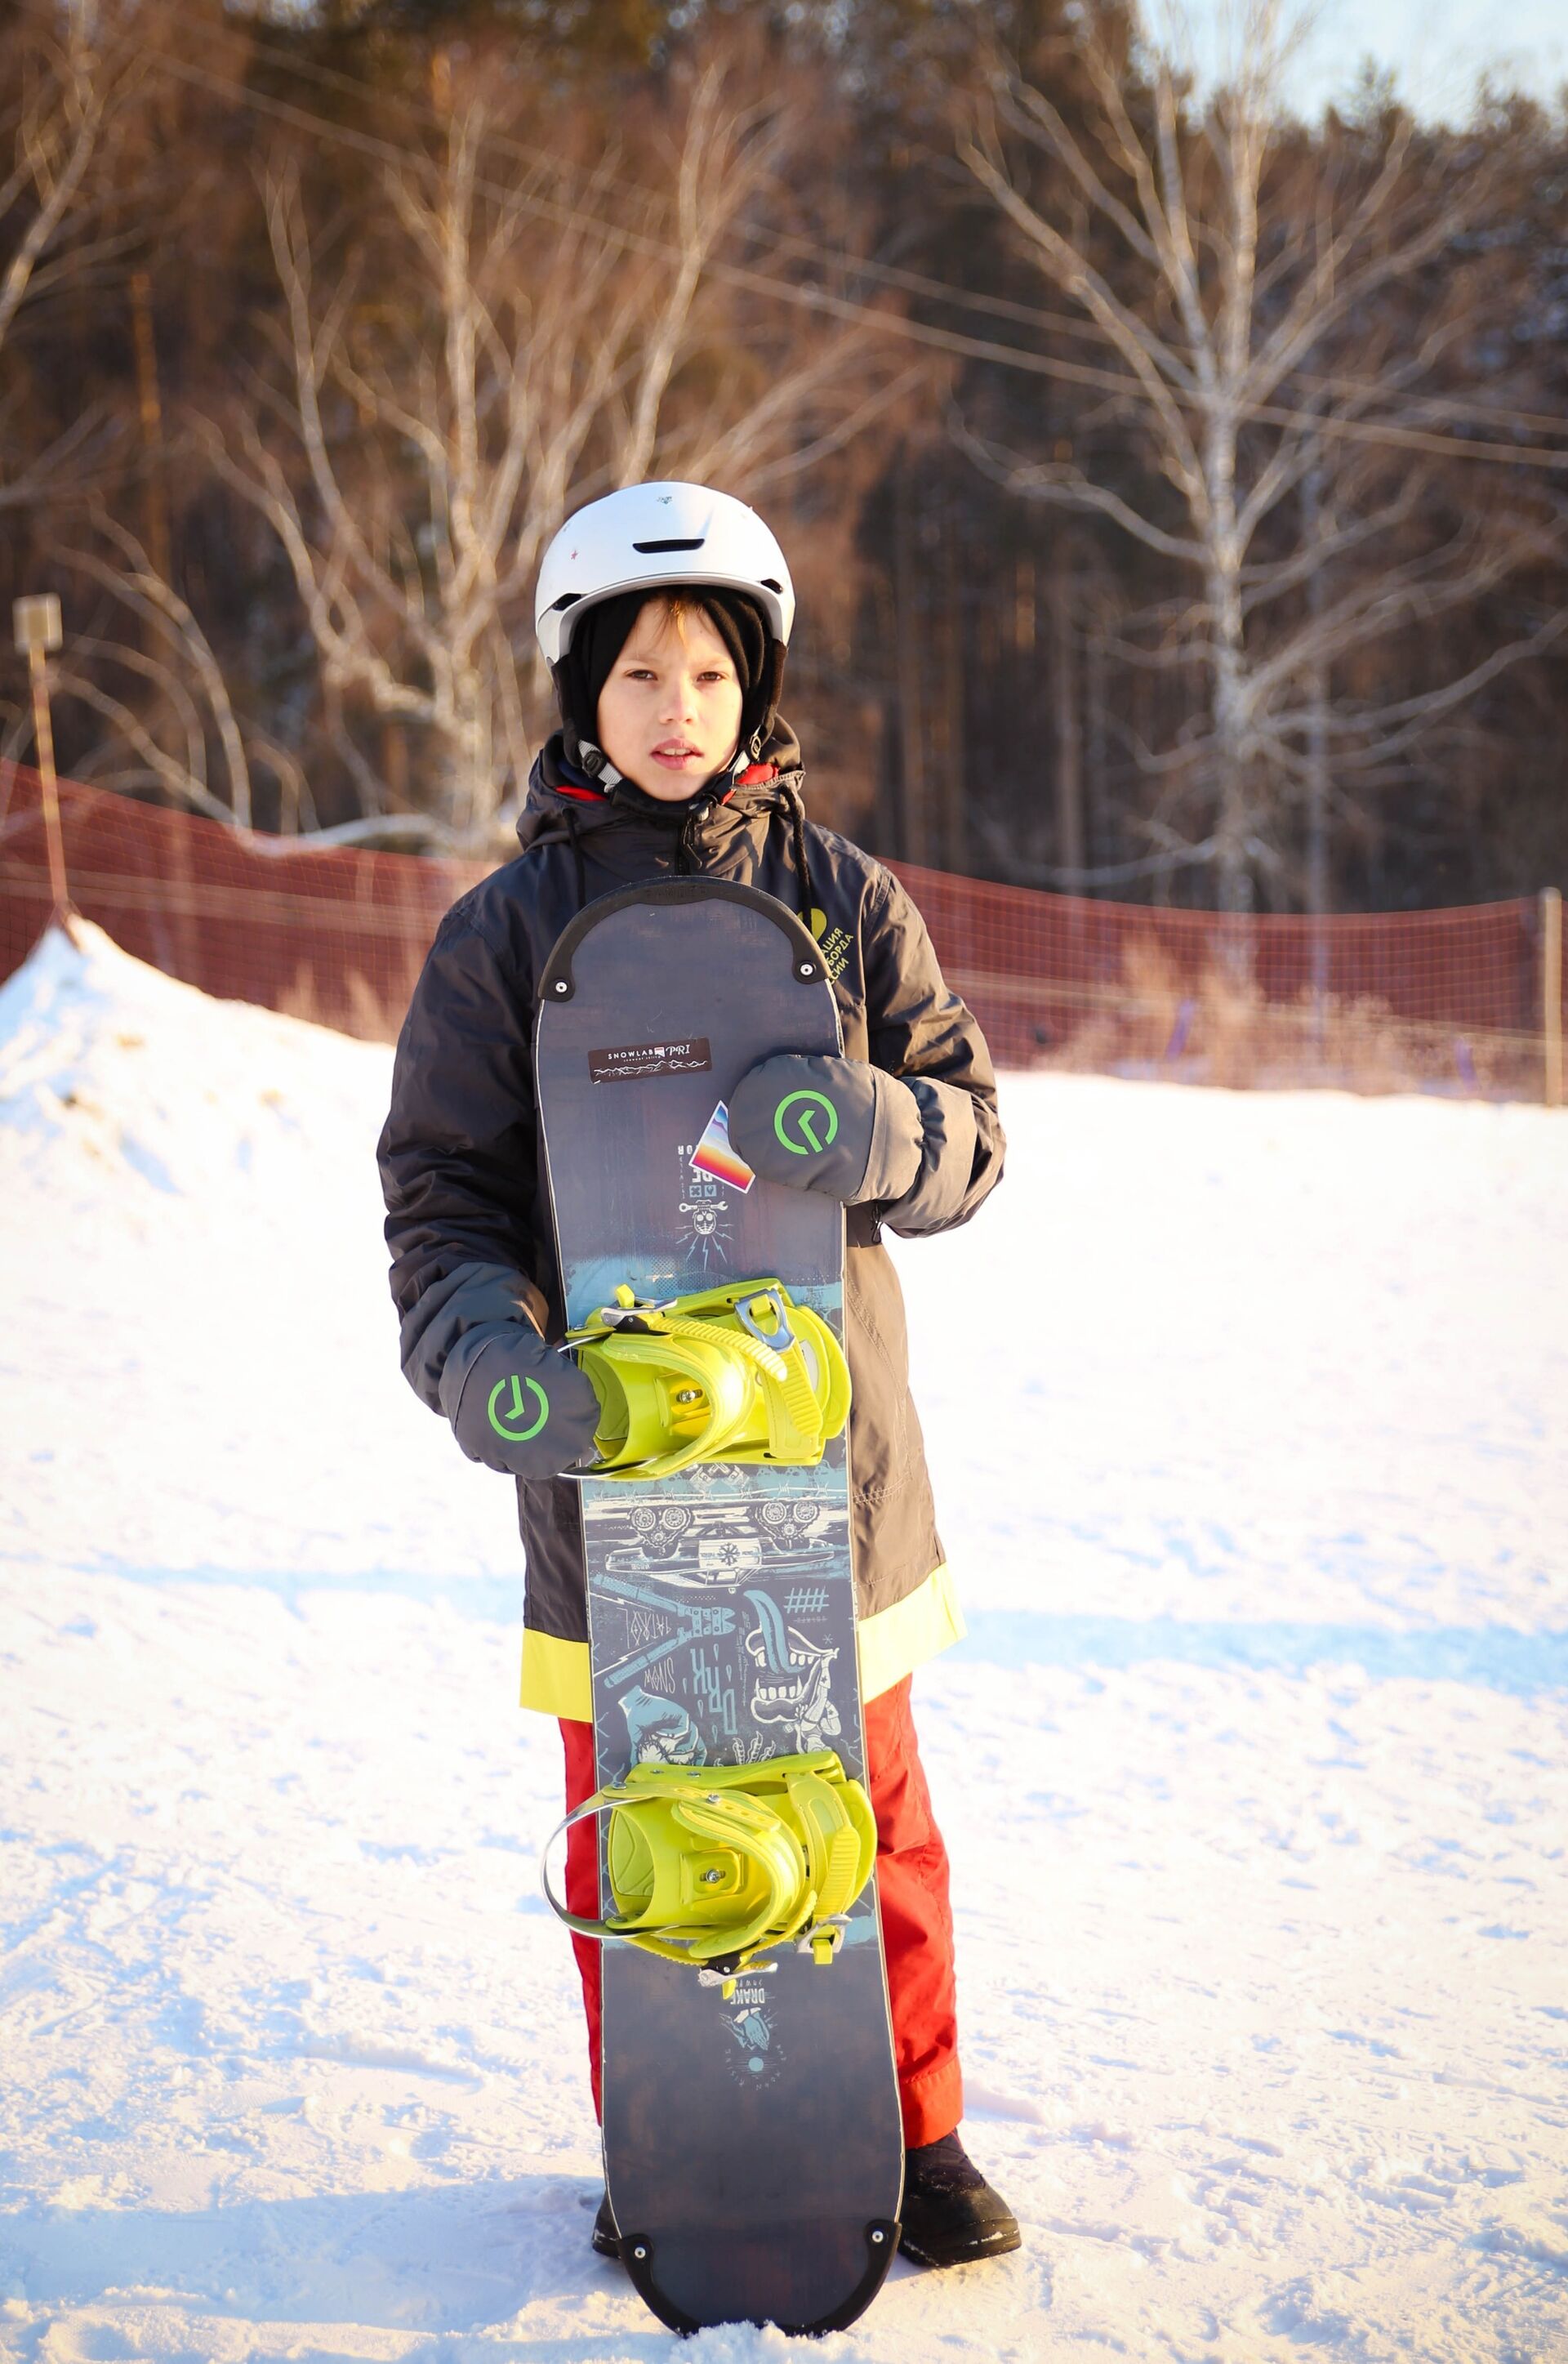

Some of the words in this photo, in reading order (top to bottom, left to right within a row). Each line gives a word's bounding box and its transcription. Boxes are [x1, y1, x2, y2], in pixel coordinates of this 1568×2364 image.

[830, 957, 849, 984] СИИ
[608, 1049, 653, 1059] SNOWLAB
[644, 1657, 675, 1694] SNOW
